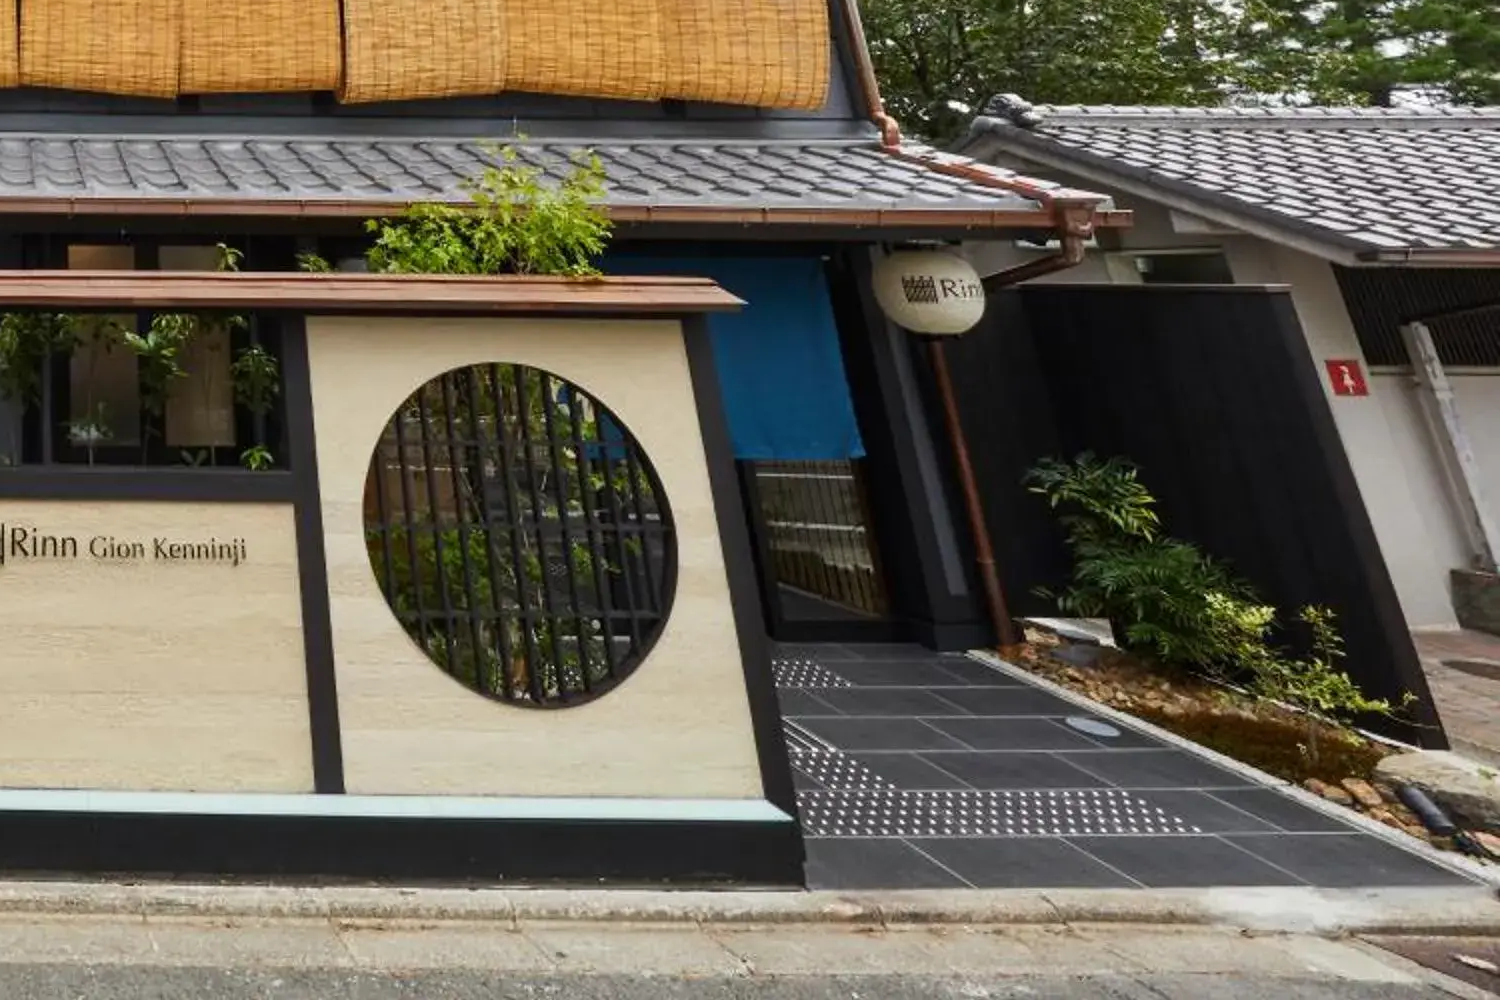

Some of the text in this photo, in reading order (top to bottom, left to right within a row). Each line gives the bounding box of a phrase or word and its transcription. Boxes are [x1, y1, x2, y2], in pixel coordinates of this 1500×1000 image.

[11, 527, 247, 567] Rinn Gion Kenninji
